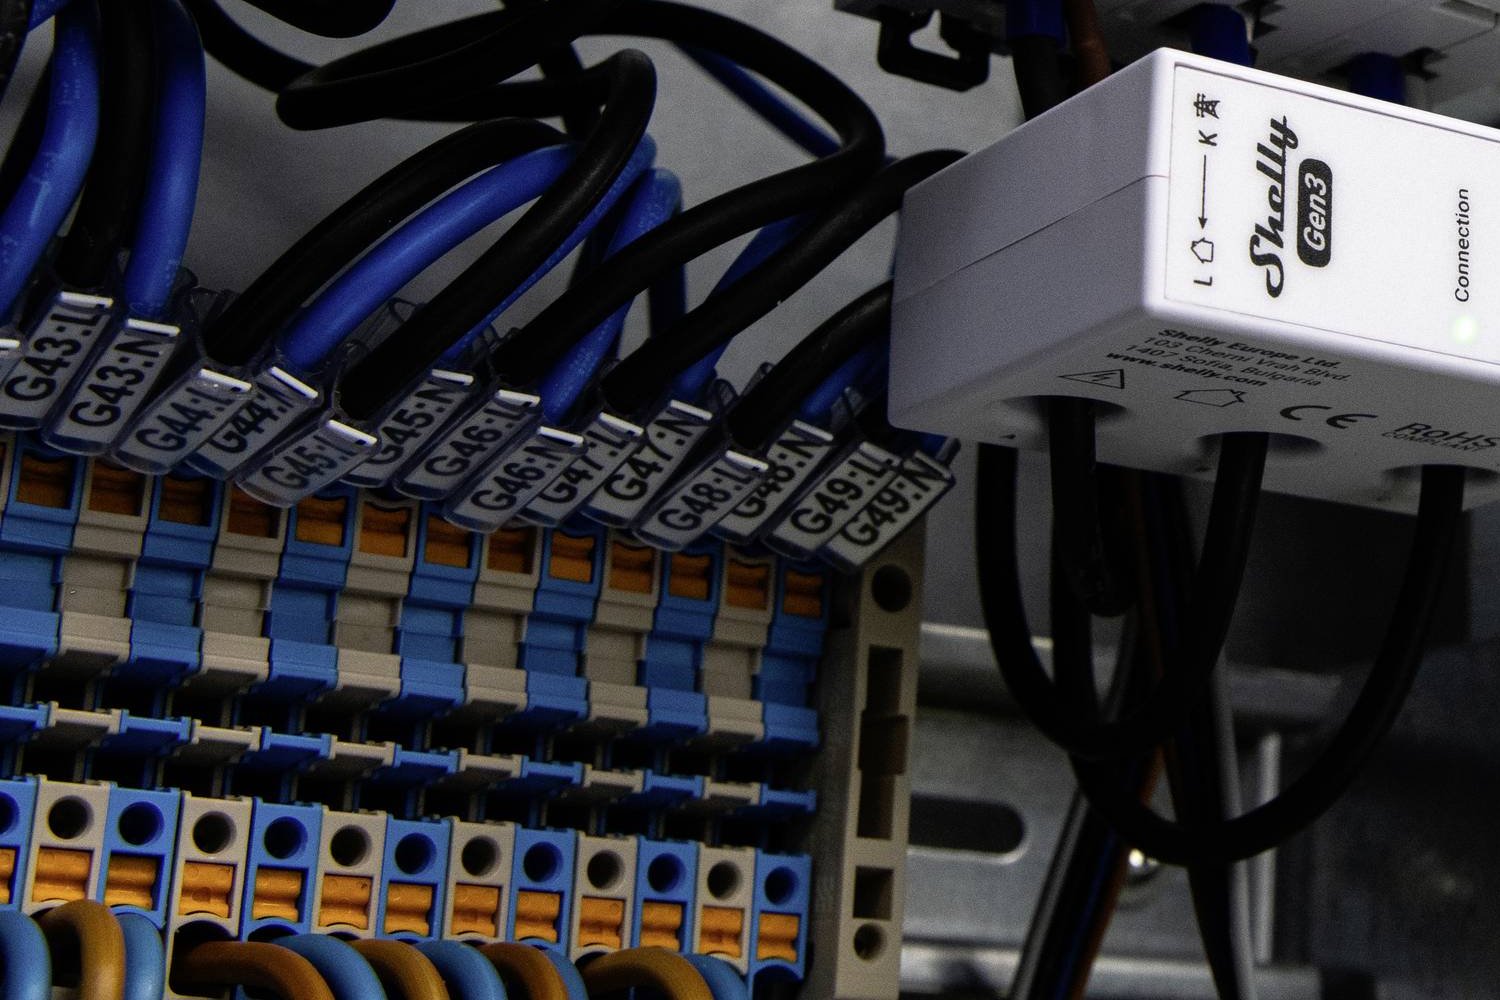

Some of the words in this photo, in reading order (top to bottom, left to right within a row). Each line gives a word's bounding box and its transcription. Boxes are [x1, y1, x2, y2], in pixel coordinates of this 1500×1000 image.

[1198, 130, 1218, 146] K
[1250, 115, 1299, 298] Shelly
[1303, 172, 1328, 251] Gen3
[1193, 276, 1213, 287] L
[1455, 188, 1470, 303] Connection
[4, 312, 102, 401] G43:L
[70, 338, 162, 427] G43:N
[1106, 351, 1268, 387] www.shelly.com
[1125, 344, 1179, 358] 1407
[1241, 366, 1322, 386] Bulgaria
[1145, 337, 1183, 349] 103
[1255, 357, 1301, 372] Vrah
[1303, 367, 1352, 382] Blvd.
[1157, 328, 1225, 347] Shelly
[1227, 342, 1300, 361] Europe
[1301, 356, 1343, 369] Ltd.
[367, 384, 456, 465] G45:N
[424, 405, 529, 477] G46:L
[604, 419, 707, 500] G47:N
[1381, 431, 1483, 451] COMPLIANT
[471, 445, 564, 511] G46:N
[658, 466, 752, 532] G48:L
[790, 458, 893, 534] G49:L
[841, 465, 949, 546] G49:N
